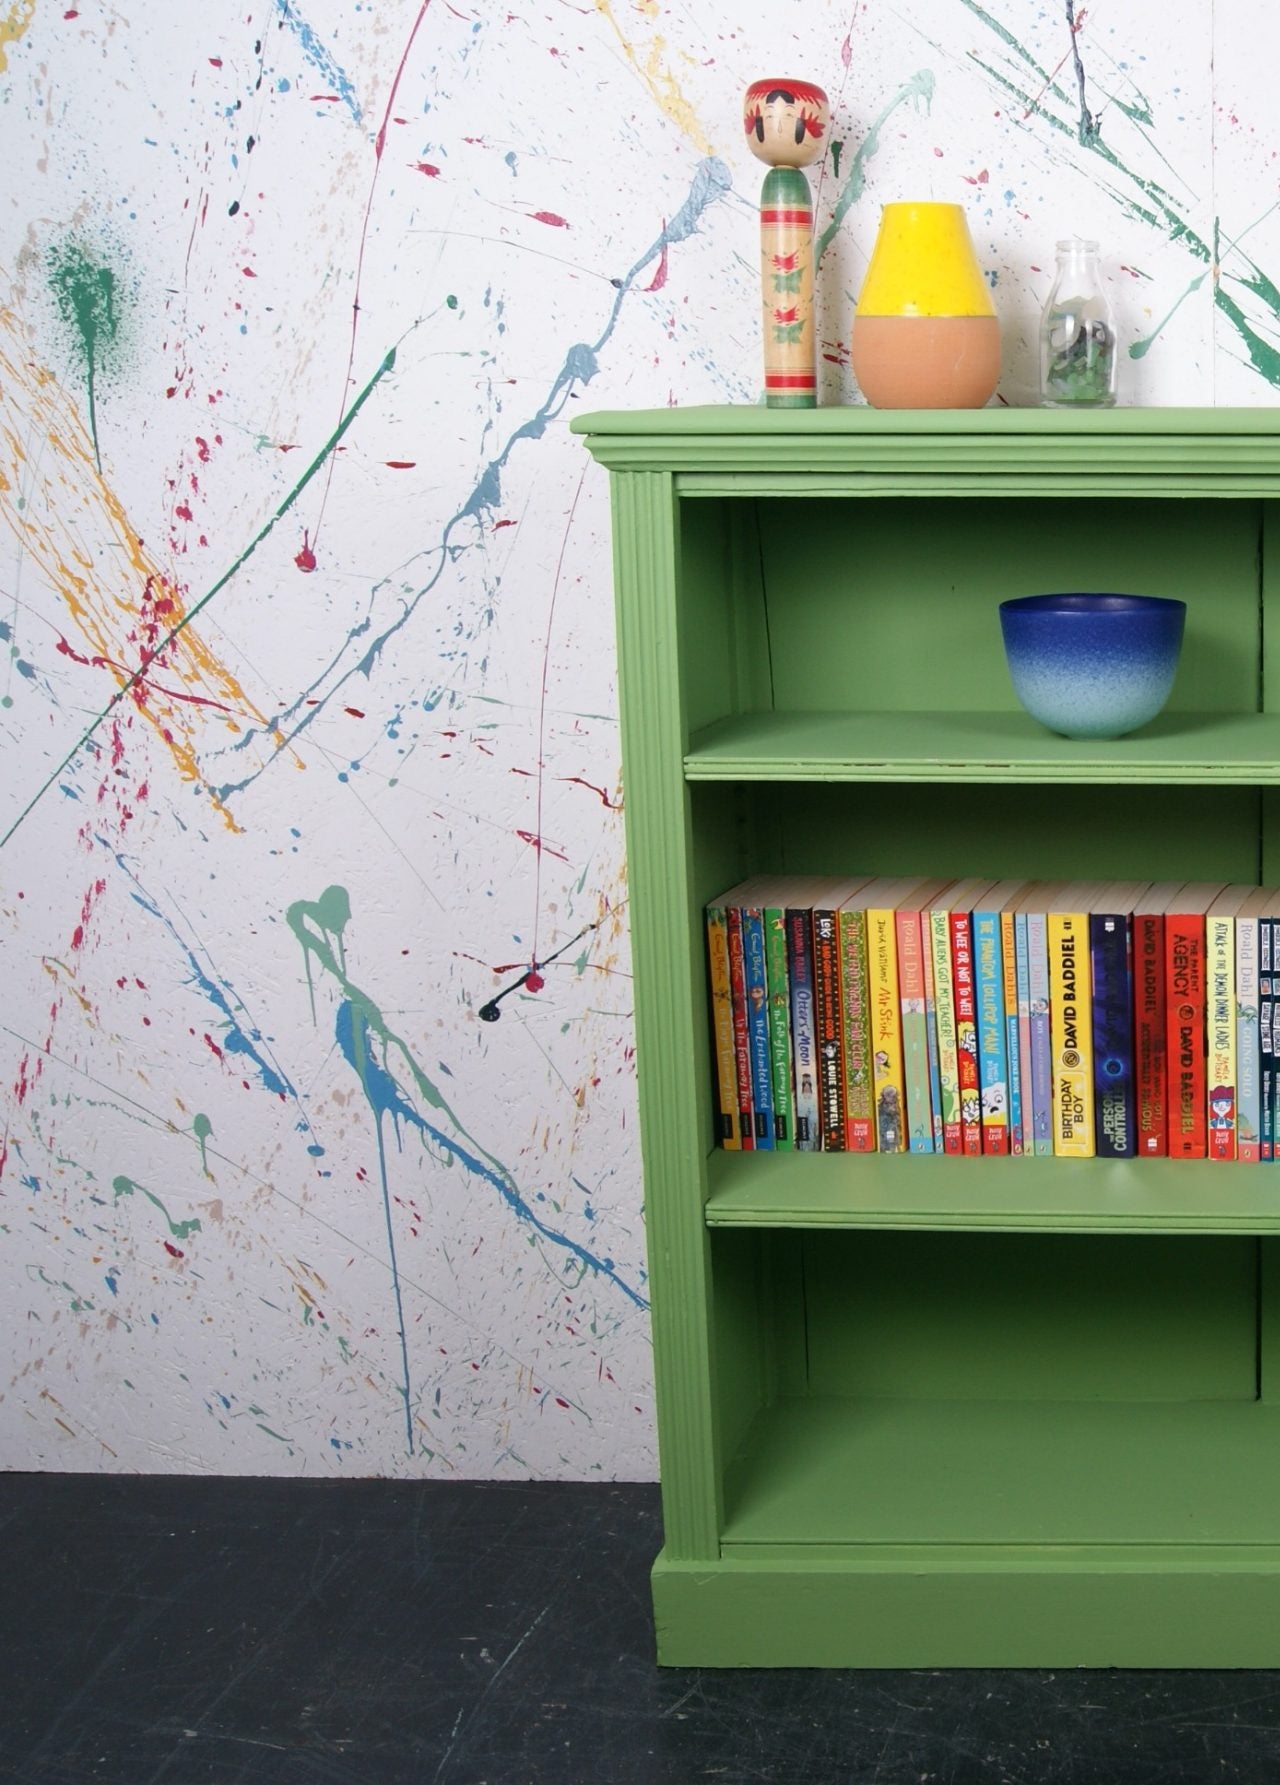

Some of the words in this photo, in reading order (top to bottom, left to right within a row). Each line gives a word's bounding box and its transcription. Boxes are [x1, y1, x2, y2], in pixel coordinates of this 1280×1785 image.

[794, 917, 804, 953] SUSANNA
[876, 920, 887, 943] David
[903, 920, 918, 955] Roald
[935, 917, 947, 936] BABY
[956, 931, 969, 949] WEE
[980, 919, 994, 934] THE
[1004, 922, 1015, 958] Roald
[1018, 922, 1027, 958] Roald
[1031, 922, 1042, 956] Roald
[1144, 920, 1156, 955] DAVID
[1215, 922, 1227, 947] ATTACK
[937, 939, 949, 965] ALIENS
[1190, 939, 1198, 955] THE
[1240, 924, 1253, 960] Roald
[958, 952, 969, 963] OR
[981, 938, 996, 979] PHANTOM
[1062, 936, 1076, 1000] BADDIEL
[1173, 934, 1188, 997] AGENCY
[1216, 960, 1225, 970] THE
[905, 963, 919, 993] Dahl
[938, 967, 949, 983] GOT
[959, 967, 970, 983] NOT
[1019, 965, 1028, 995] Dahl
[1032, 965, 1043, 995] Dahl
[1144, 960, 1157, 1014] BADDIEL
[1190, 959, 1199, 992] PARENT
[1214, 973, 1228, 997] DEMON
[1240, 967, 1253, 997] Dahl
[848, 981, 862, 1018] FRIENDS
[878, 987, 892, 1005] Mr
[940, 988, 950, 999] MY
[960, 998, 973, 1015] WEE!
[983, 984, 998, 1024] LOLLIPOP
[797, 991, 811, 1030] Otters'
[880, 1009, 893, 1041] Stink
[940, 1003, 953, 1038] TEACHER!
[1215, 999, 1228, 1023] DINNER
[756, 1020, 765, 1035] The
[775, 1021, 786, 1038] Folk
[825, 1019, 834, 1039] GOOD
[850, 1021, 863, 1041] FAN
[985, 1027, 1000, 1053] MAN!
[1063, 1007, 1077, 1049] DAVID
[1216, 1026, 1231, 1050] LADIES
[756, 1036, 767, 1082] Enchanted
[798, 1031, 812, 1066] Moon
[852, 1044, 864, 1069] CLUB
[1180, 1026, 1193, 1068] DAVID
[1242, 1027, 1251, 1065] GOING
[738, 1047, 749, 1087] Faraway
[776, 1062, 787, 1094] Faraway
[828, 1060, 837, 1085] LOUIE
[1222, 1056, 1230, 1080] PAMELA
[1242, 1067, 1252, 1097] SOLO
[725, 1091, 733, 1109] Tree
[741, 1091, 750, 1108] Tree
[760, 1085, 768, 1108] Wood
[780, 1097, 788, 1114] Tree
[828, 1088, 838, 1128] STOWELL
[1061, 1079, 1073, 1139] BIRTHDAY
[1074, 1095, 1083, 1123] BOY
[1181, 1072, 1194, 1135] BADDIEL
